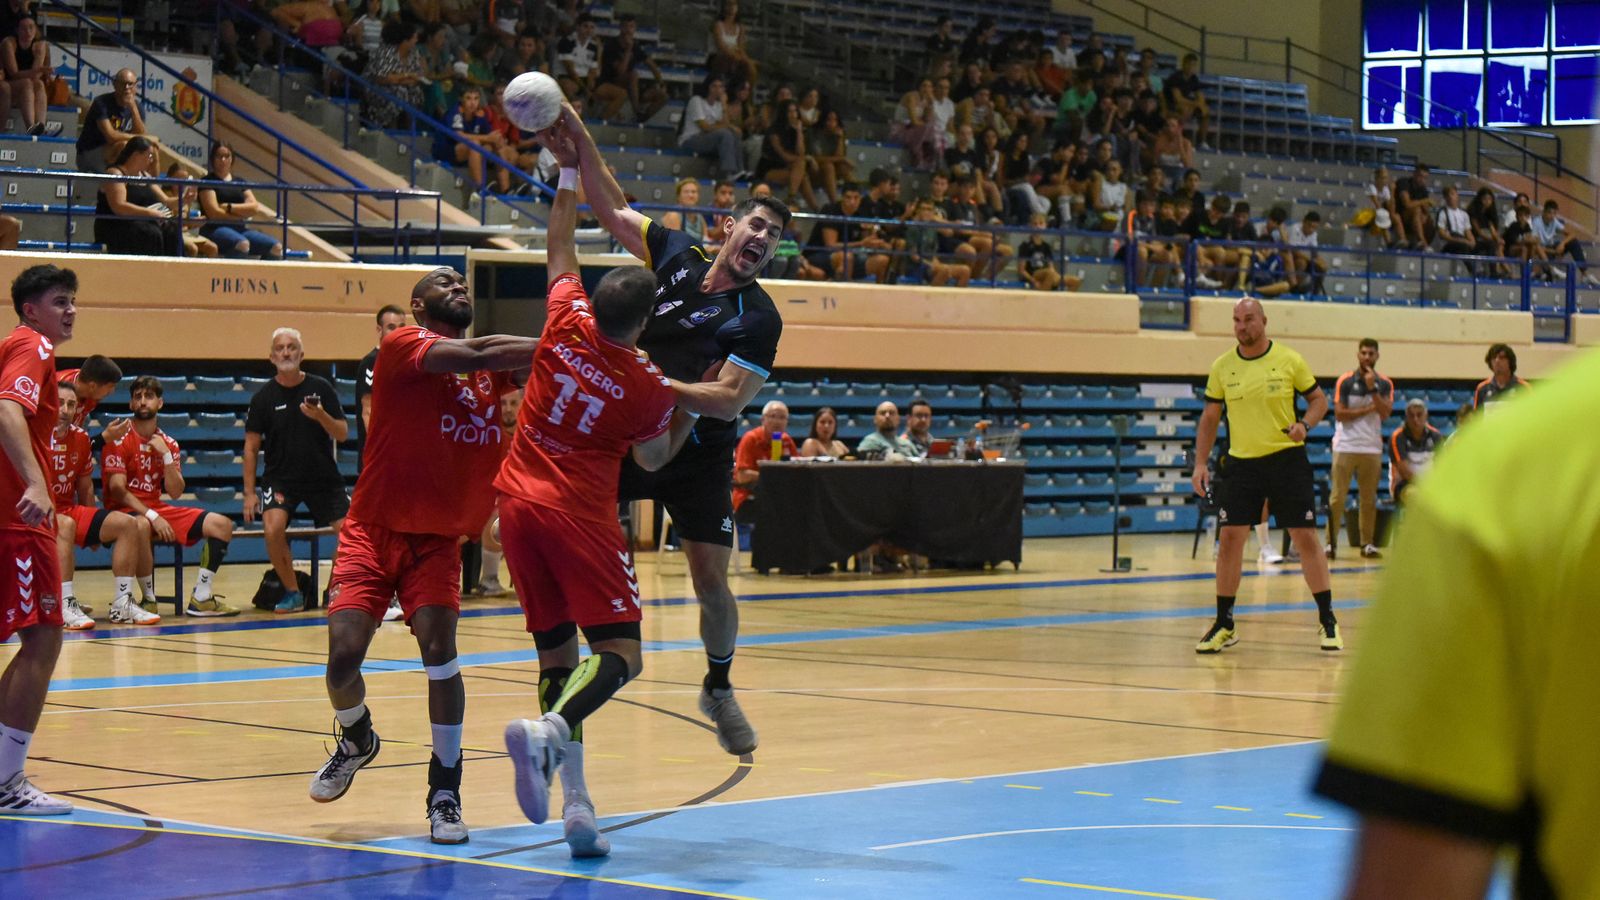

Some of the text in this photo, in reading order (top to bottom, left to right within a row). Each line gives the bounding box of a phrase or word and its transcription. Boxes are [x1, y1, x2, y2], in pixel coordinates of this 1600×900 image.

[210, 277, 279, 295] PRENSA
[343, 280, 367, 296] TV
[552, 342, 625, 400] FRAGERO
[547, 372, 606, 435] 11
[52, 454, 66, 471] 15
[140, 454, 152, 471] 34
